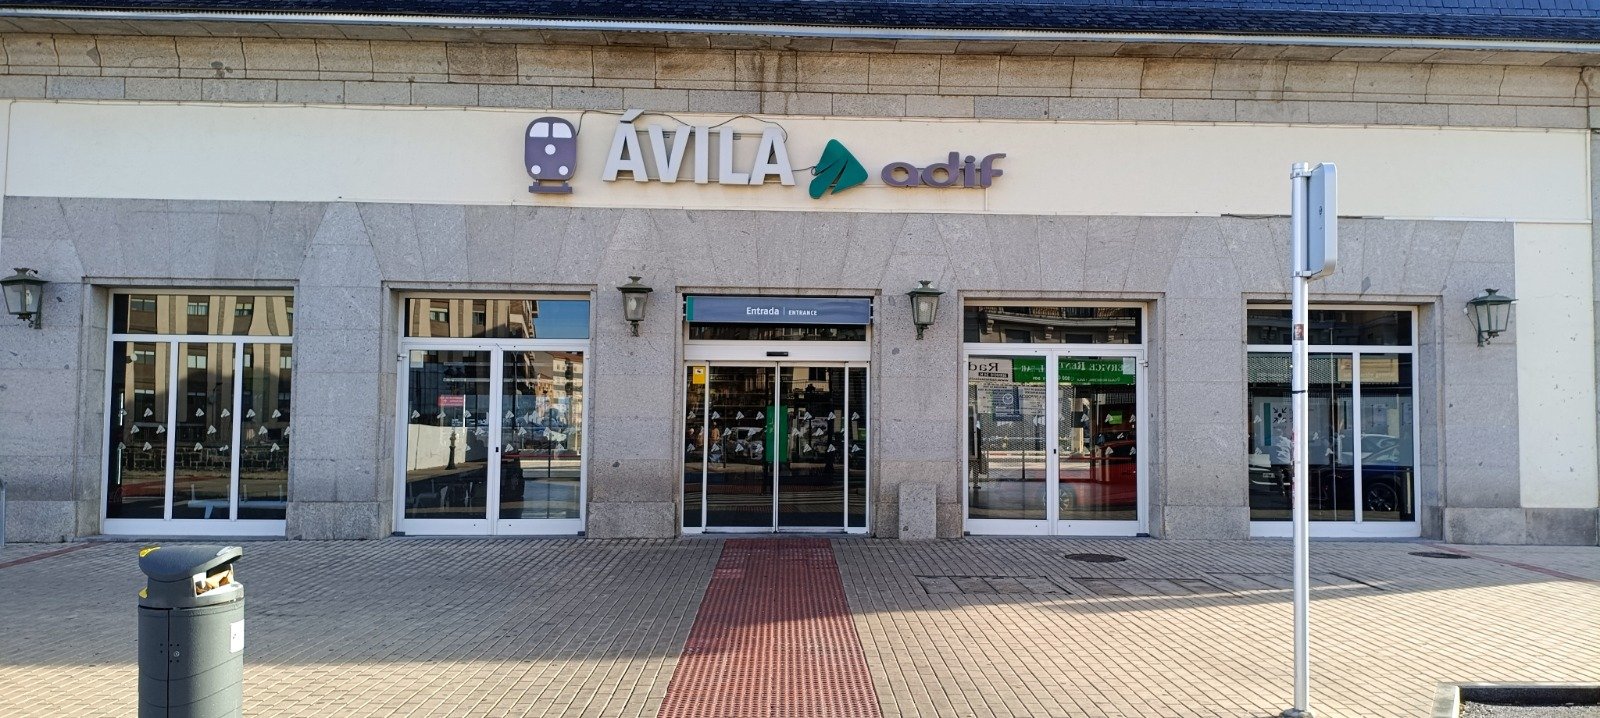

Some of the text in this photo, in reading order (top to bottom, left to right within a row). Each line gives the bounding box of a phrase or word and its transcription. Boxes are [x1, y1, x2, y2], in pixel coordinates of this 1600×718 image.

[602, 108, 795, 185] ÁVILA
[881, 151, 1008, 188] adif
[746, 306, 780, 315] Entrada
